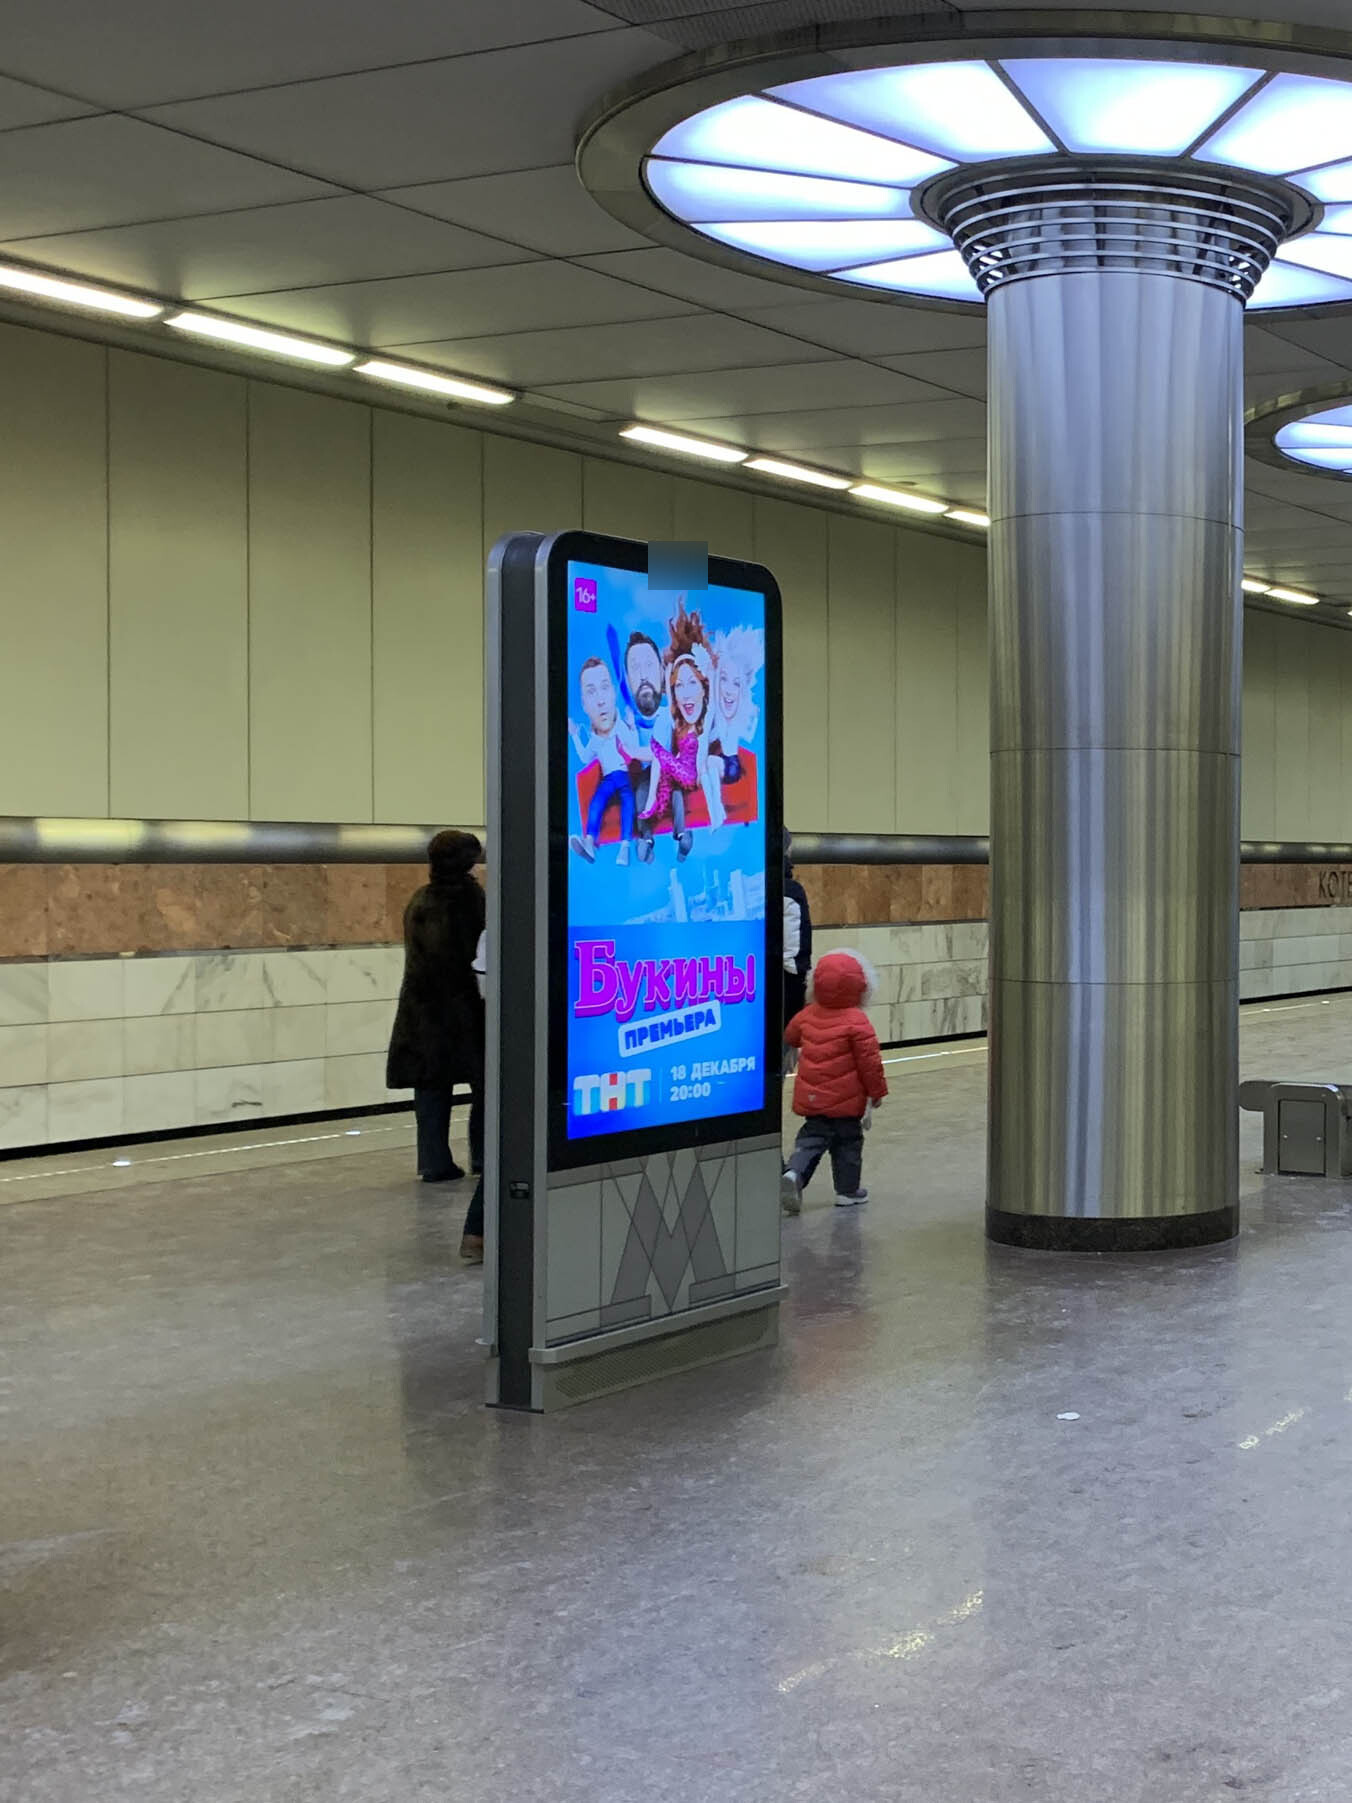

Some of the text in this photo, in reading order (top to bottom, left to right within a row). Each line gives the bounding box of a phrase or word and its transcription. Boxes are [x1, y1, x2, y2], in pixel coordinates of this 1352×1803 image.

[576, 586, 596, 604] 16+
[574, 939, 756, 1023] Букины
[624, 1008, 717, 1050] ПРЕМЬЕРА
[670, 1056, 756, 1082] 18 ДЕКАБРЯ
[573, 1068, 652, 1116] ТНТ
[670, 1082, 711, 1102] 20:00
